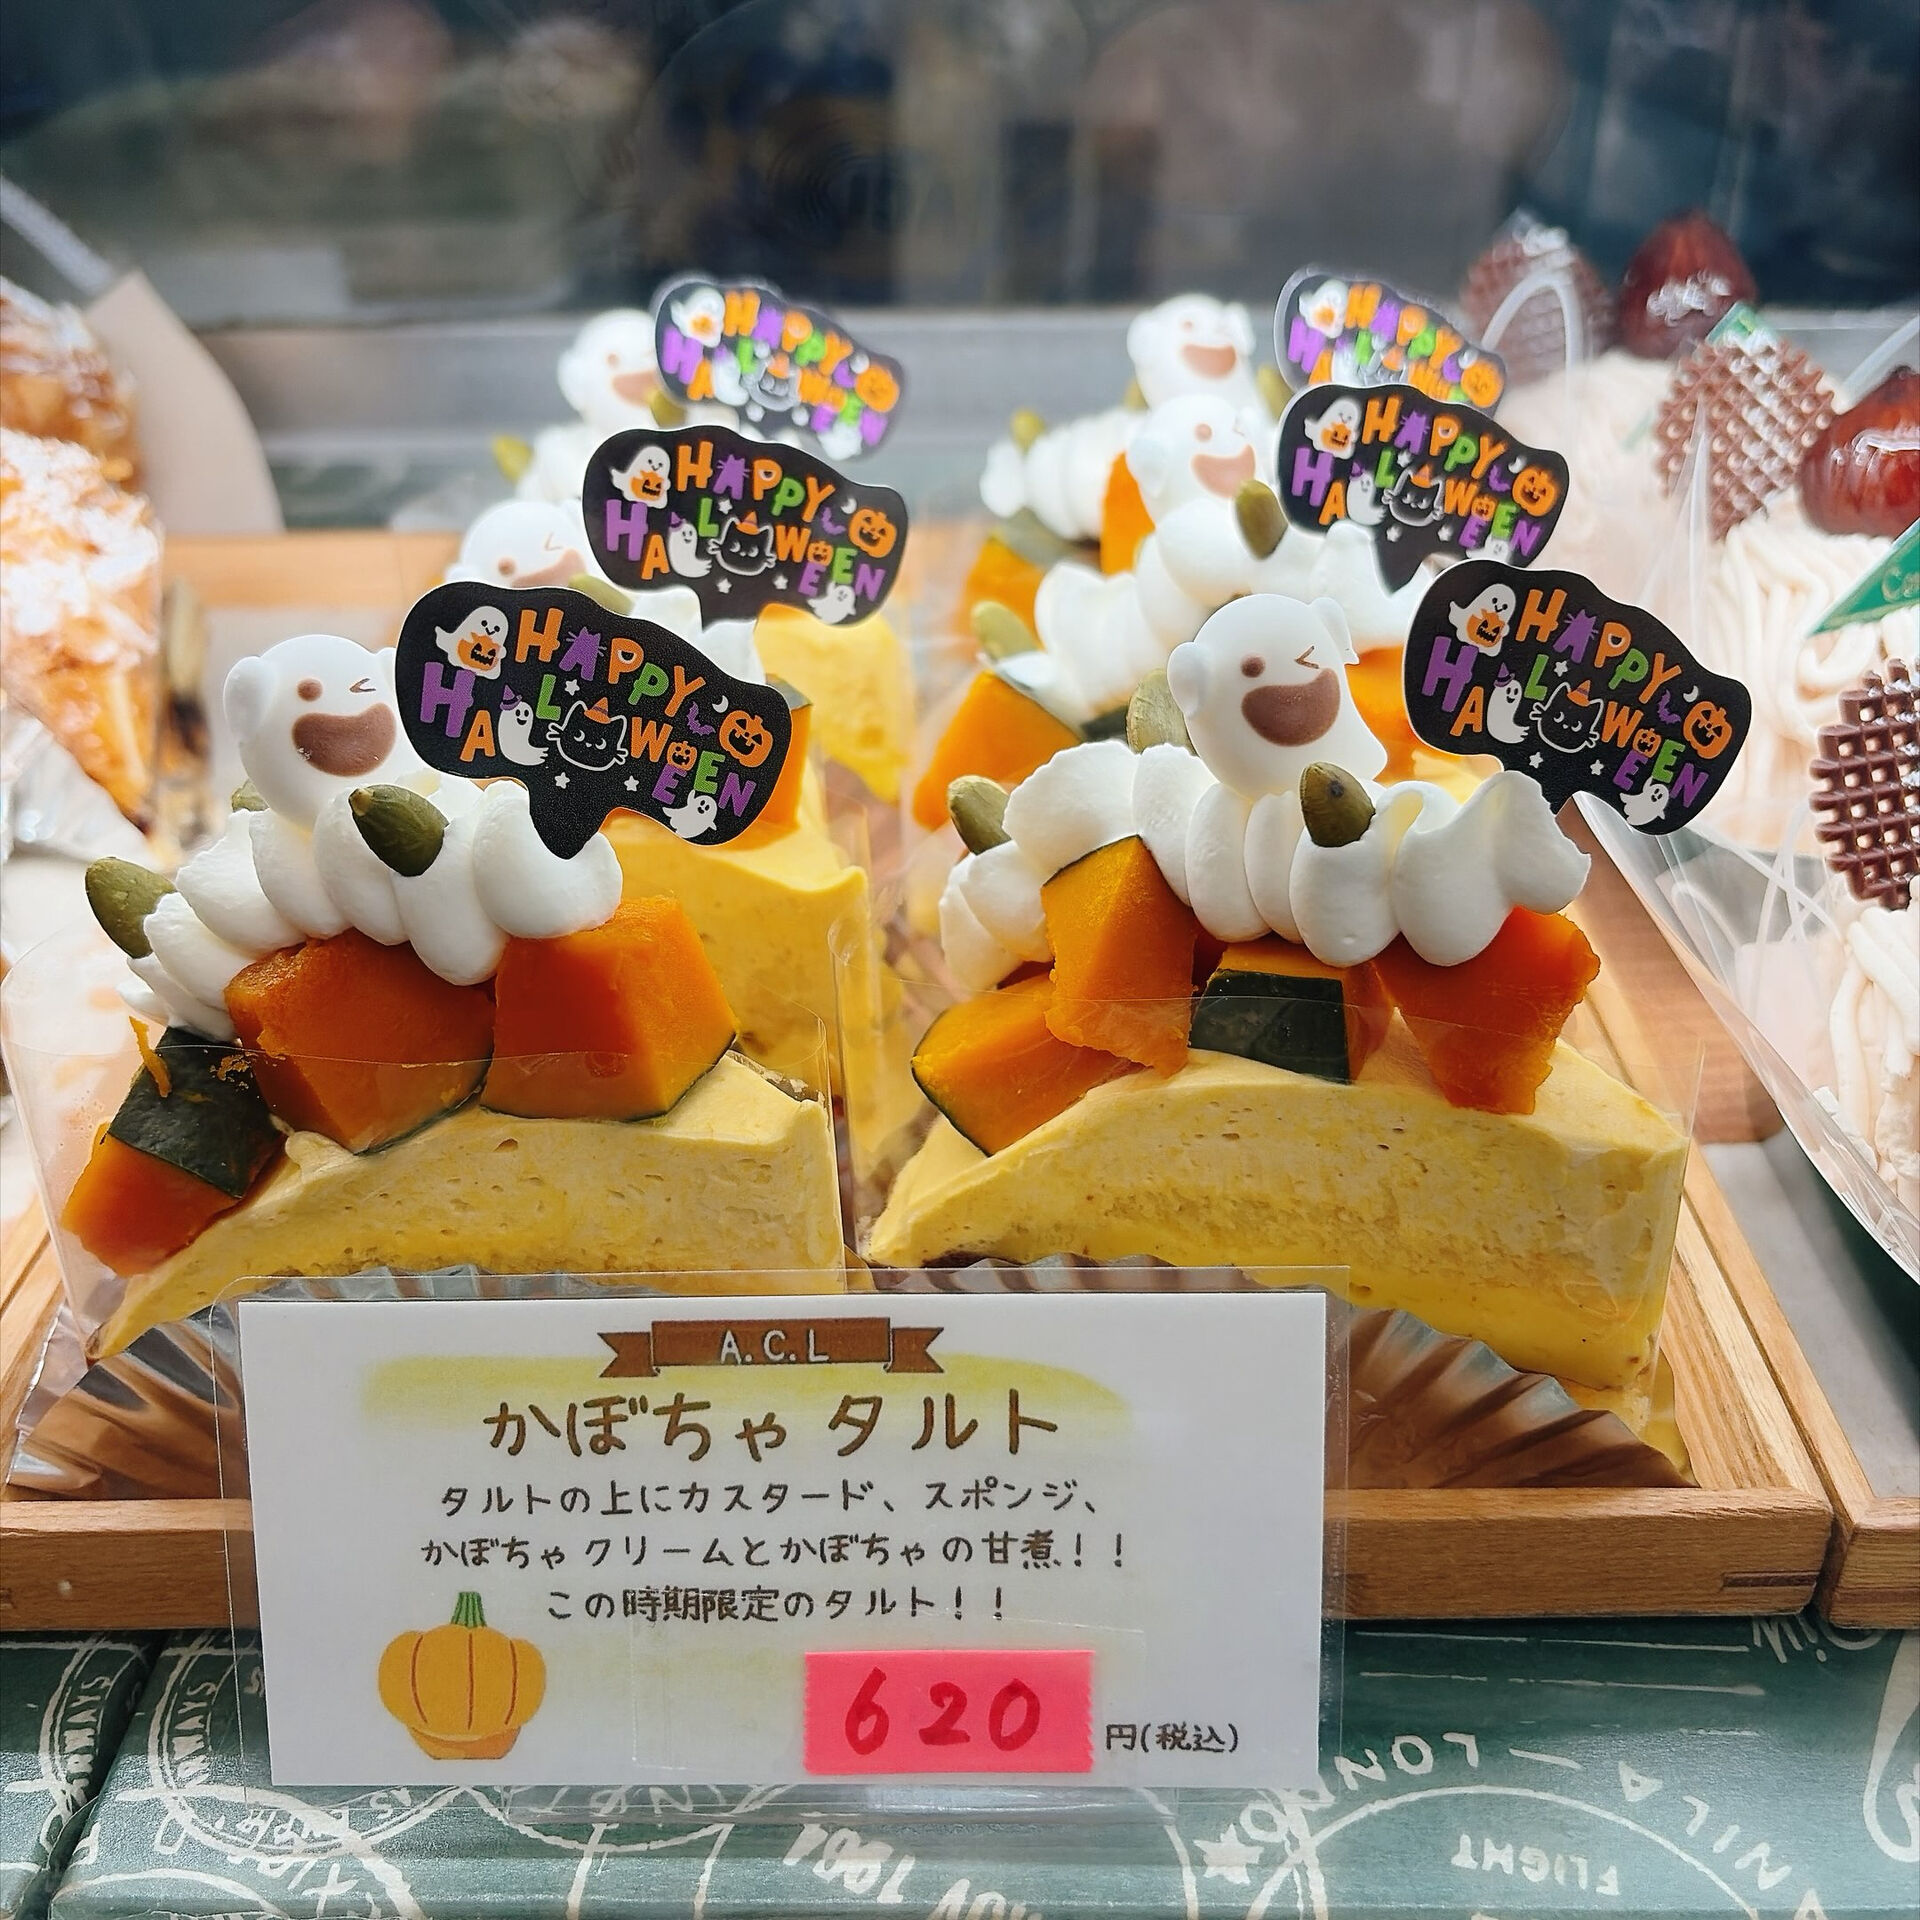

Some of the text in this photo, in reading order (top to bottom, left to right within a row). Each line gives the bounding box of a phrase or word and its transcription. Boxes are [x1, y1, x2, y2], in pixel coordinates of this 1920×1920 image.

[1362, 394, 1508, 480] HAPPY
[677, 441, 836, 523] HAPPY
[514, 607, 706, 718] HAPPY
[1515, 588, 1683, 704] HAPPY
[719, 1329, 830, 1364] A.C.L
[483, 1388, 1058, 1462] かぼちゃタルト
[845, 1666, 1041, 1755] 620
[1106, 1721, 1239, 1754] 円(税込)
[1450, 1833, 1620, 1896] FLIGHT
